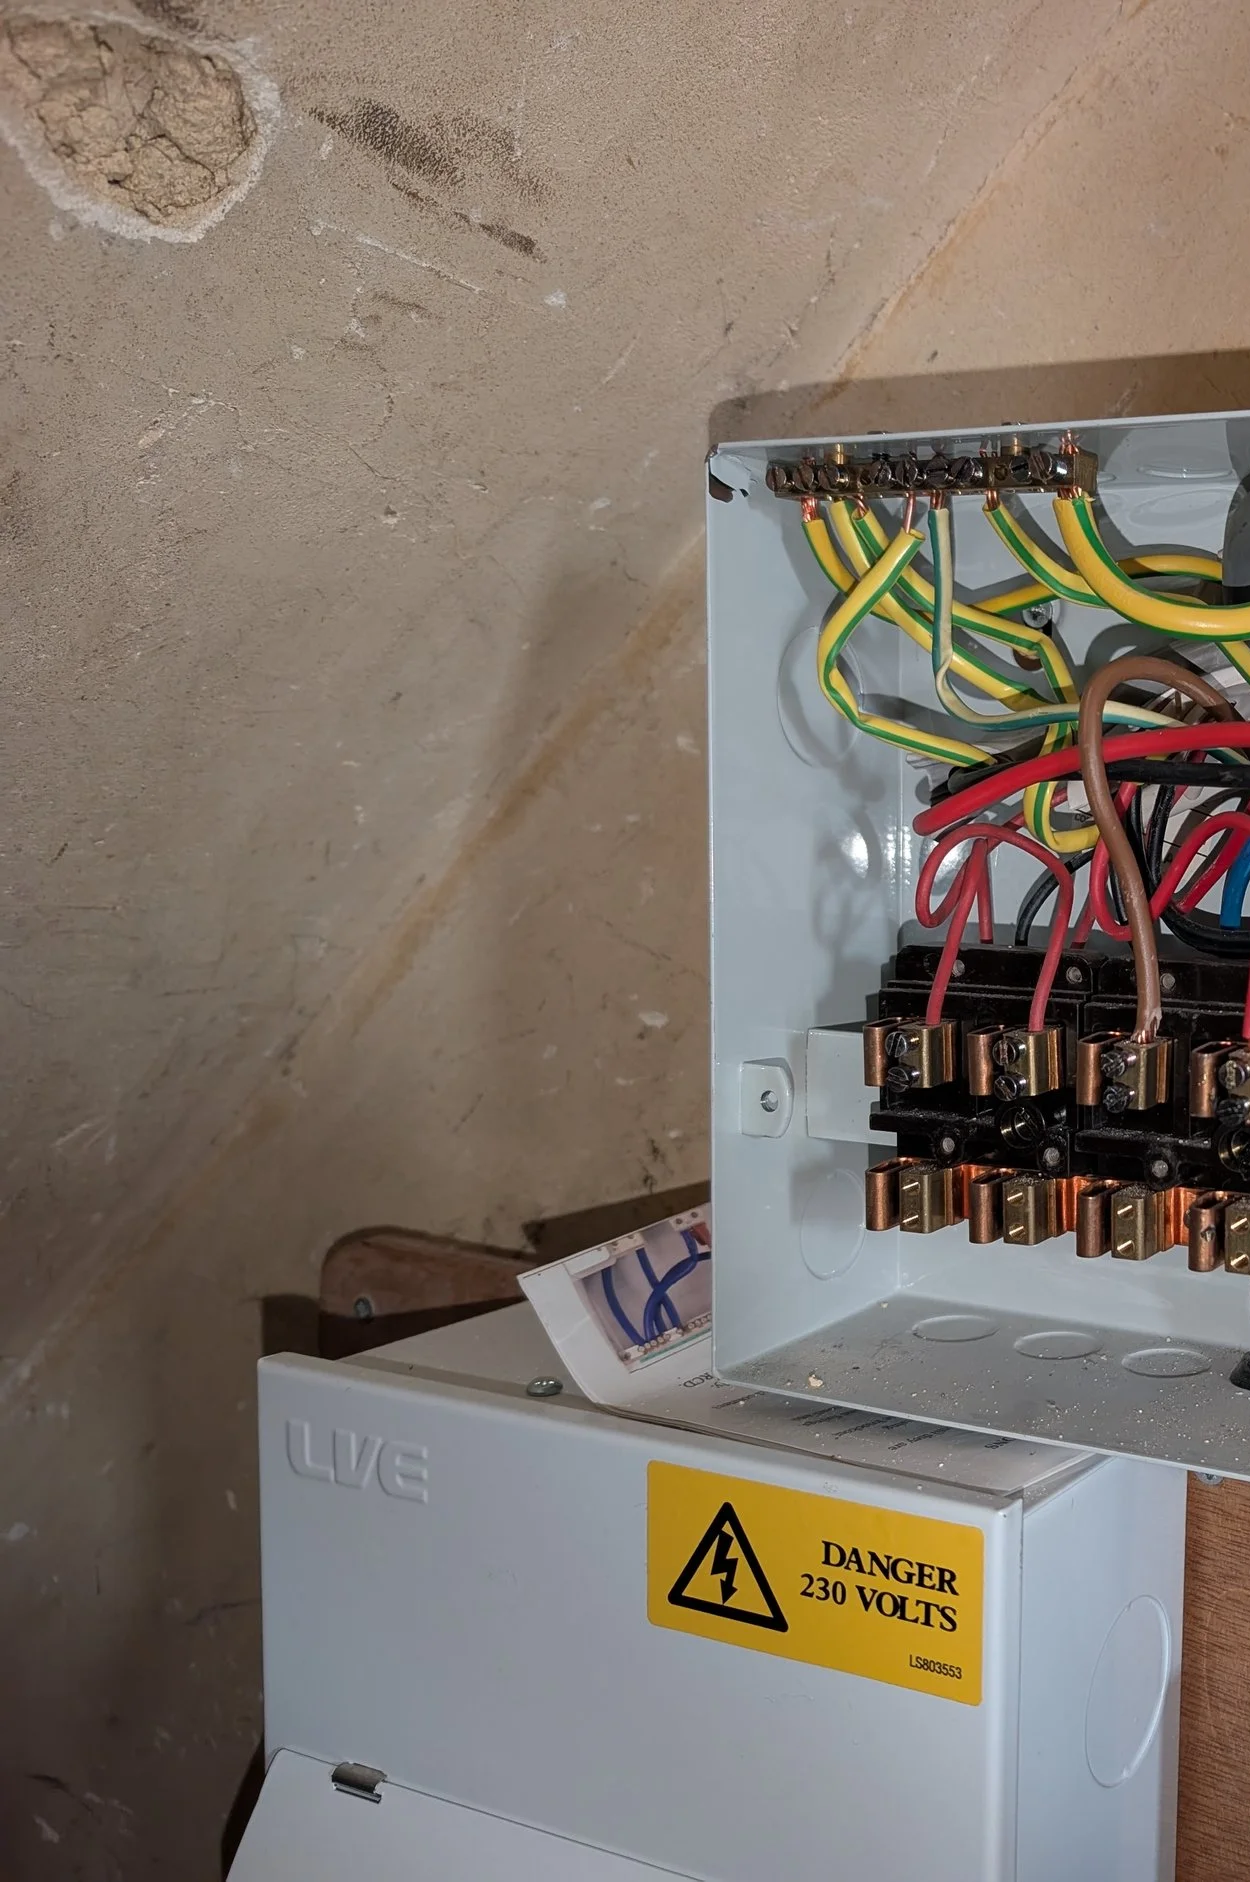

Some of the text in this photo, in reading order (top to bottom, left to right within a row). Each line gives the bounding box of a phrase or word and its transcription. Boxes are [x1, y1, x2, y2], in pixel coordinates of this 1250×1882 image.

[821, 1540, 959, 1596] DANGER
[800, 1573, 957, 1632] 230 VOLTS
[909, 1654, 962, 1680] LS803553
